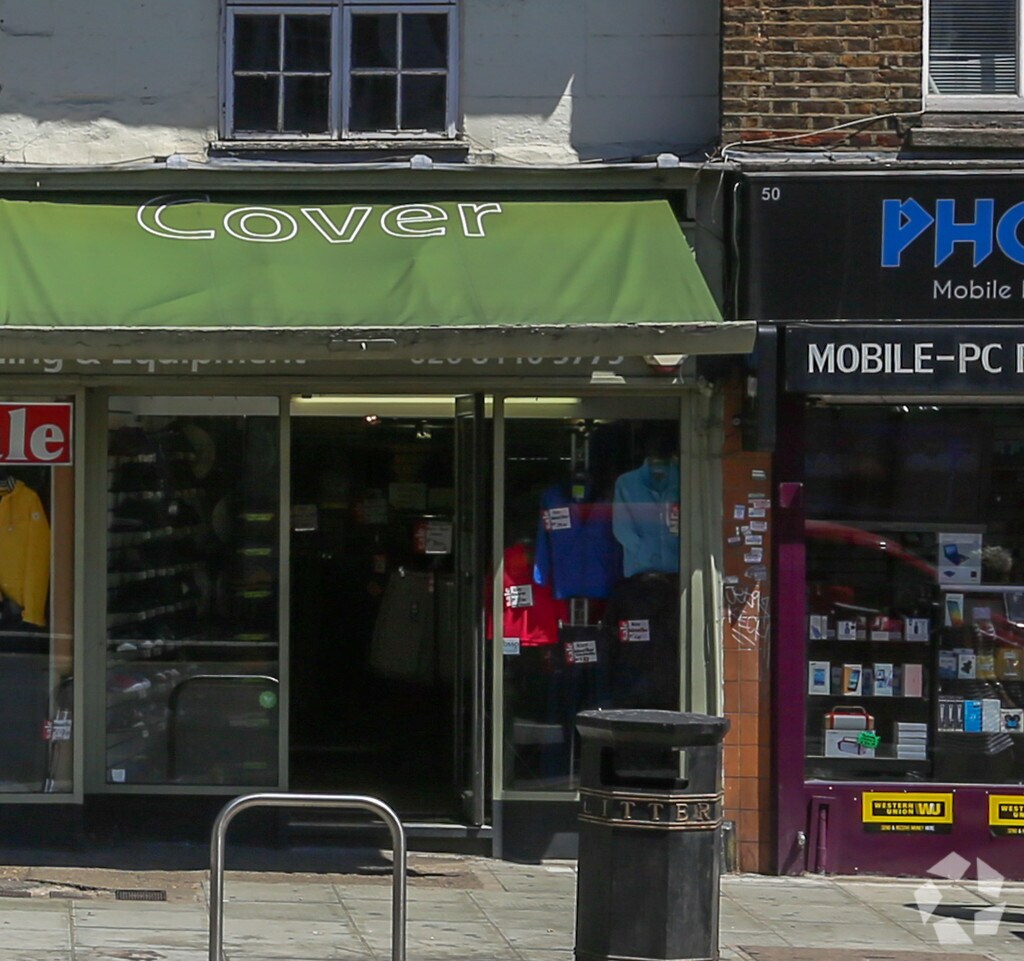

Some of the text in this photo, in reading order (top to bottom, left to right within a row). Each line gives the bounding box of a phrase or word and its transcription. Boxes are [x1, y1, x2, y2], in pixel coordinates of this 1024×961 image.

[761, 187, 781, 201] 50
[137, 194, 502, 243] Cover
[933, 279, 1012, 299] Mobile
[808, 343, 1002, 373] MOBILE-PC
[583, 800, 711, 822] LITTER
[916, 802, 942, 816] WU
